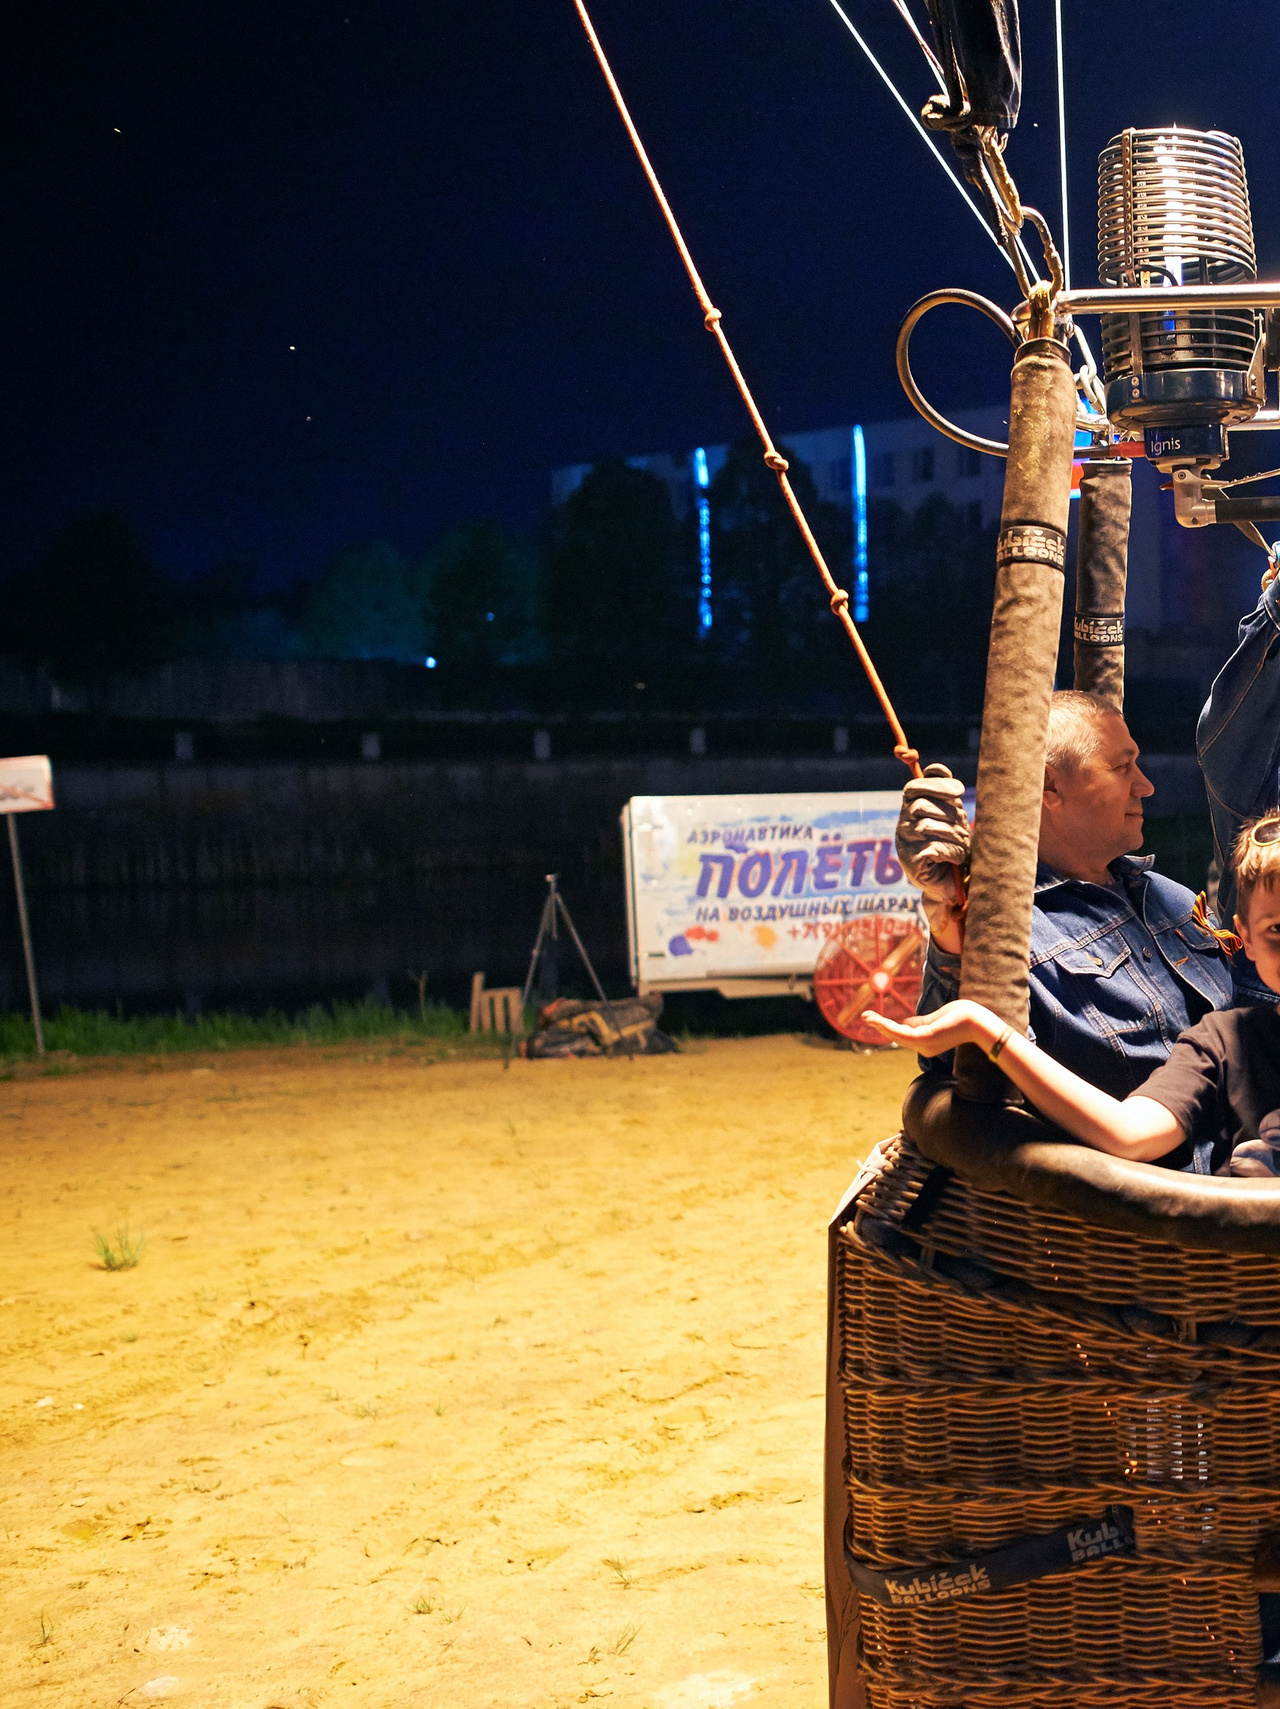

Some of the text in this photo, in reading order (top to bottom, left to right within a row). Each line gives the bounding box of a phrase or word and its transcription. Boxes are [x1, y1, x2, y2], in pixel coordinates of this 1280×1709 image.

[1150, 437, 1181, 456] Ignis
[996, 529, 1065, 557] ubíček
[996, 546, 1064, 566] ALLOONS
[1074, 616, 1123, 636] ubíček
[687, 825, 814, 845] АЭРОНАВТИКА
[696, 897, 920, 922] НА ВОЗДУШНЫХ ШАРАХ
[890, 1579, 991, 1604] BALLOONS
